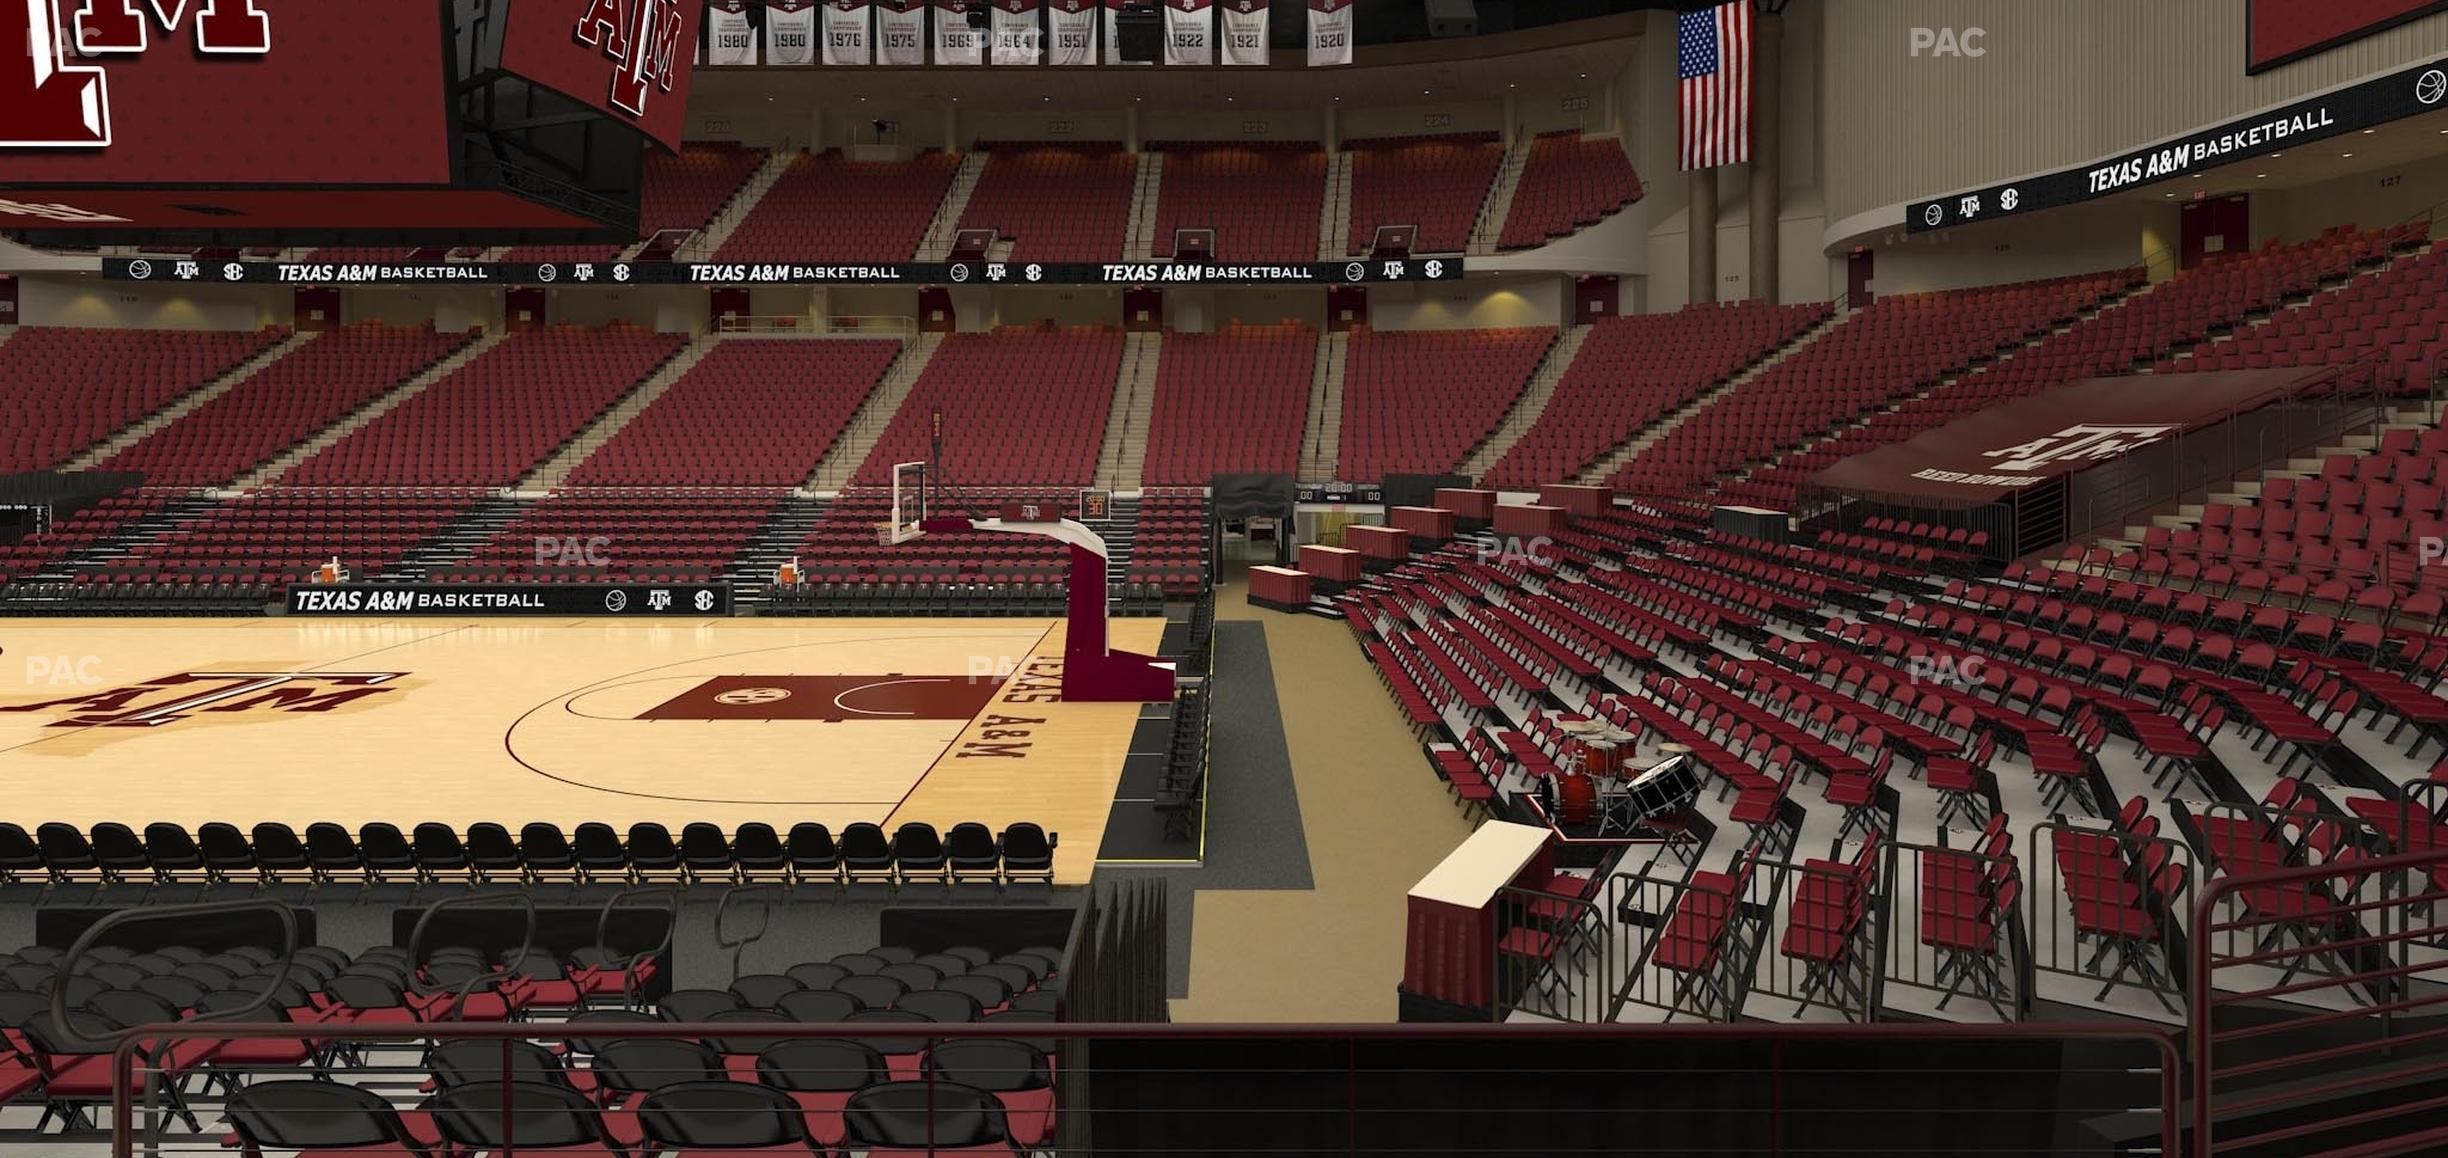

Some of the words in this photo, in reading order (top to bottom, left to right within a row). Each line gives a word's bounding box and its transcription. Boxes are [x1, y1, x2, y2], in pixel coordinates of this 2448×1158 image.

[717, 34, 749, 48] 1980
[774, 34, 806, 48] 1980
[829, 33, 861, 47] 1976
[885, 34, 916, 48] 1975
[942, 34, 974, 48] 1969
[998, 34, 1030, 48] 1964
[1058, 34, 1087, 48] 1951
[1173, 33, 1203, 47] 1922
[1231, 35, 1259, 48] 1921
[1315, 34, 1344, 49] 1920
[2088, 156, 2143, 194] TEXAS
[2144, 144, 2190, 179] A&M
[2193, 107, 2334, 162] BASKETBALL
[279, 265, 333, 280] TEXAS
[337, 265, 377, 281] A&M
[381, 267, 487, 278] BASKETBALL
[691, 265, 745, 281] TEXAS
[749, 265, 789, 281] A&M
[794, 267, 899, 278] BASKETBALL
[1103, 265, 1157, 280] TEXAS
[1161, 265, 1201, 281] A&M
[1206, 267, 1312, 278] BASKETBALL
[1326, 483, 1353, 493] 20:00
[1301, 491, 1312, 500] 00
[1368, 492, 1381, 501] 00
[1088, 503, 1103, 515] 30
[297, 591, 361, 610] TEXAS
[365, 591, 414, 610] A&M
[419, 594, 544, 606] BASKETBALL
[956, 714, 1047, 758] A&M
